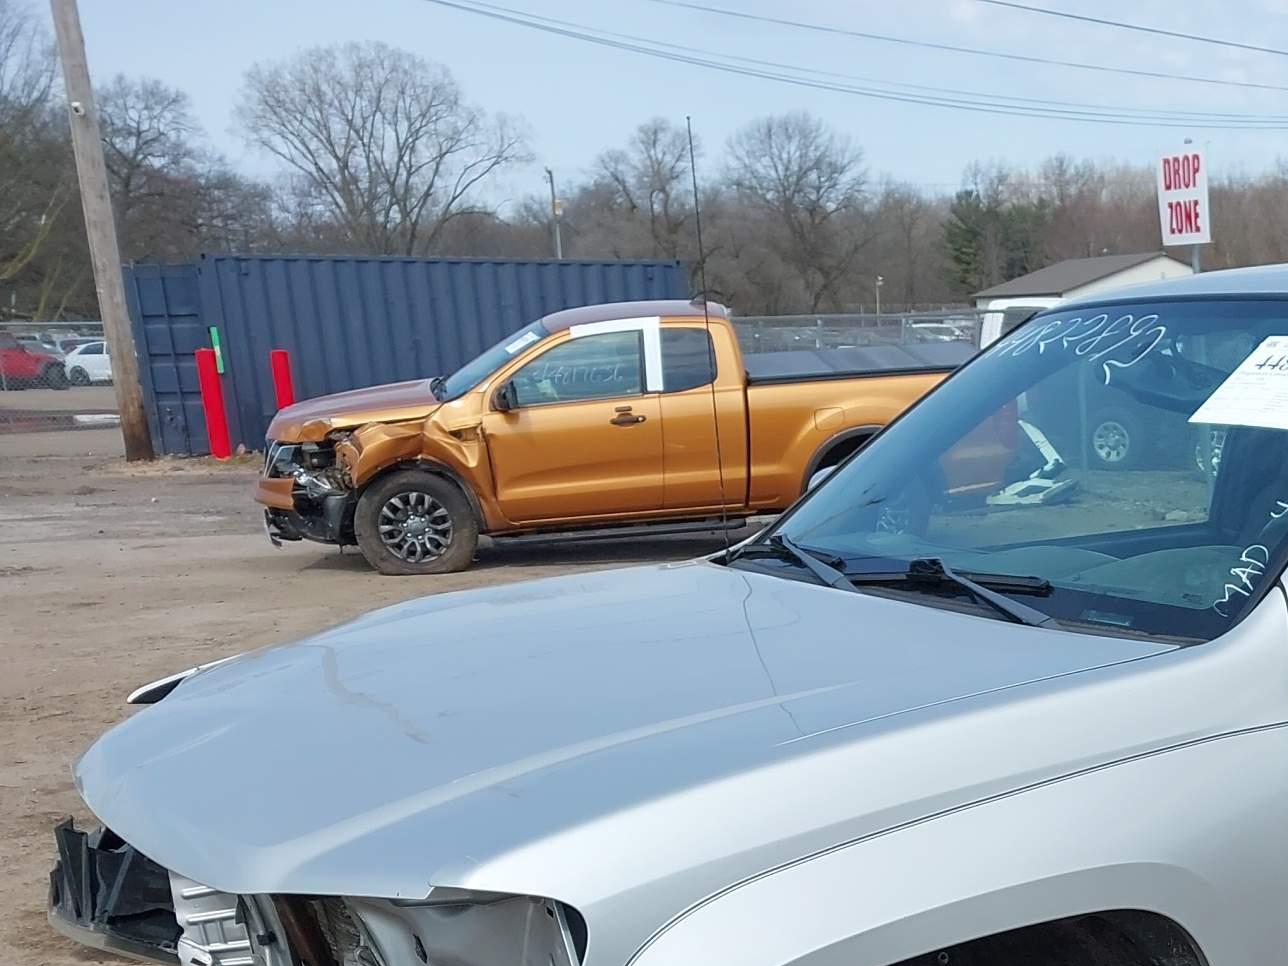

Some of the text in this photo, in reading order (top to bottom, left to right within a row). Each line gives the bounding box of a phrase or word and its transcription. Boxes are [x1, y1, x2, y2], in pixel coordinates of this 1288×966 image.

[1163, 154, 1200, 191] DROP
[1168, 200, 1200, 234] ZONE
[1213, 544, 1269, 617] MAD
